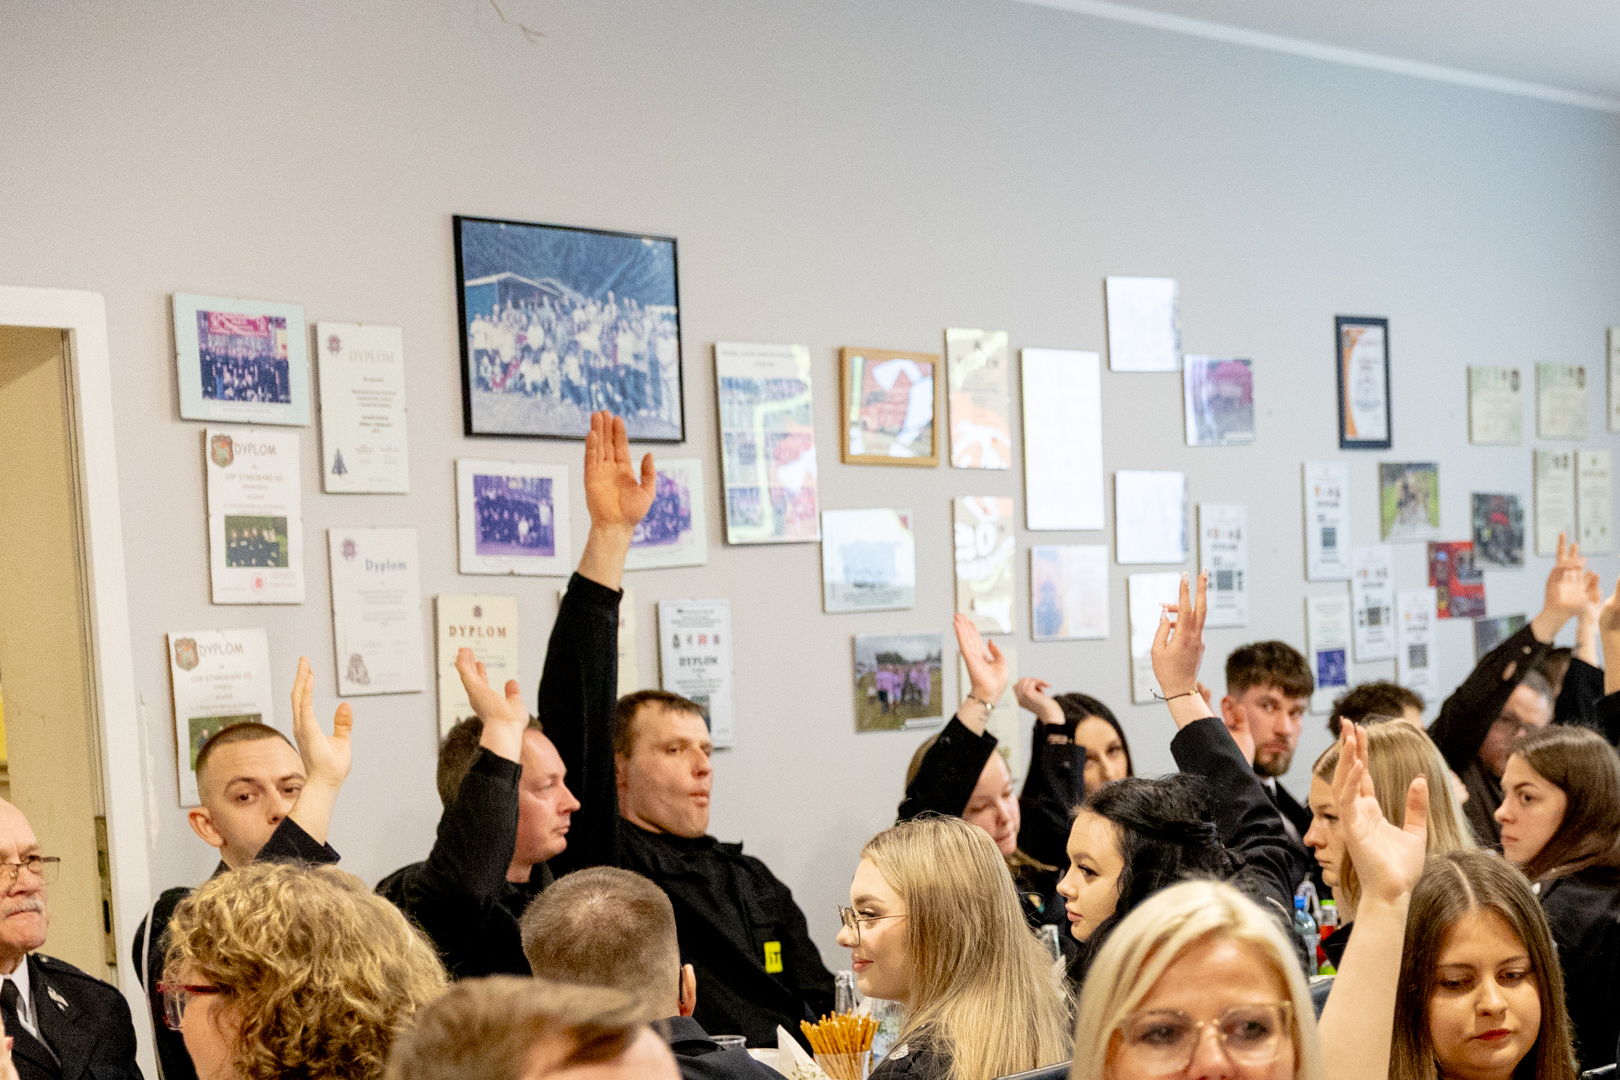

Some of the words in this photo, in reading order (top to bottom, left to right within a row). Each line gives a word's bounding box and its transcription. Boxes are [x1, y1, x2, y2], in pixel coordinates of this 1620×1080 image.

[234, 443, 277, 455] DYPLOM
[365, 559, 407, 572] Dyplom
[449, 625, 507, 638] DYPLOM
[199, 642, 243, 656] DYPLOM
